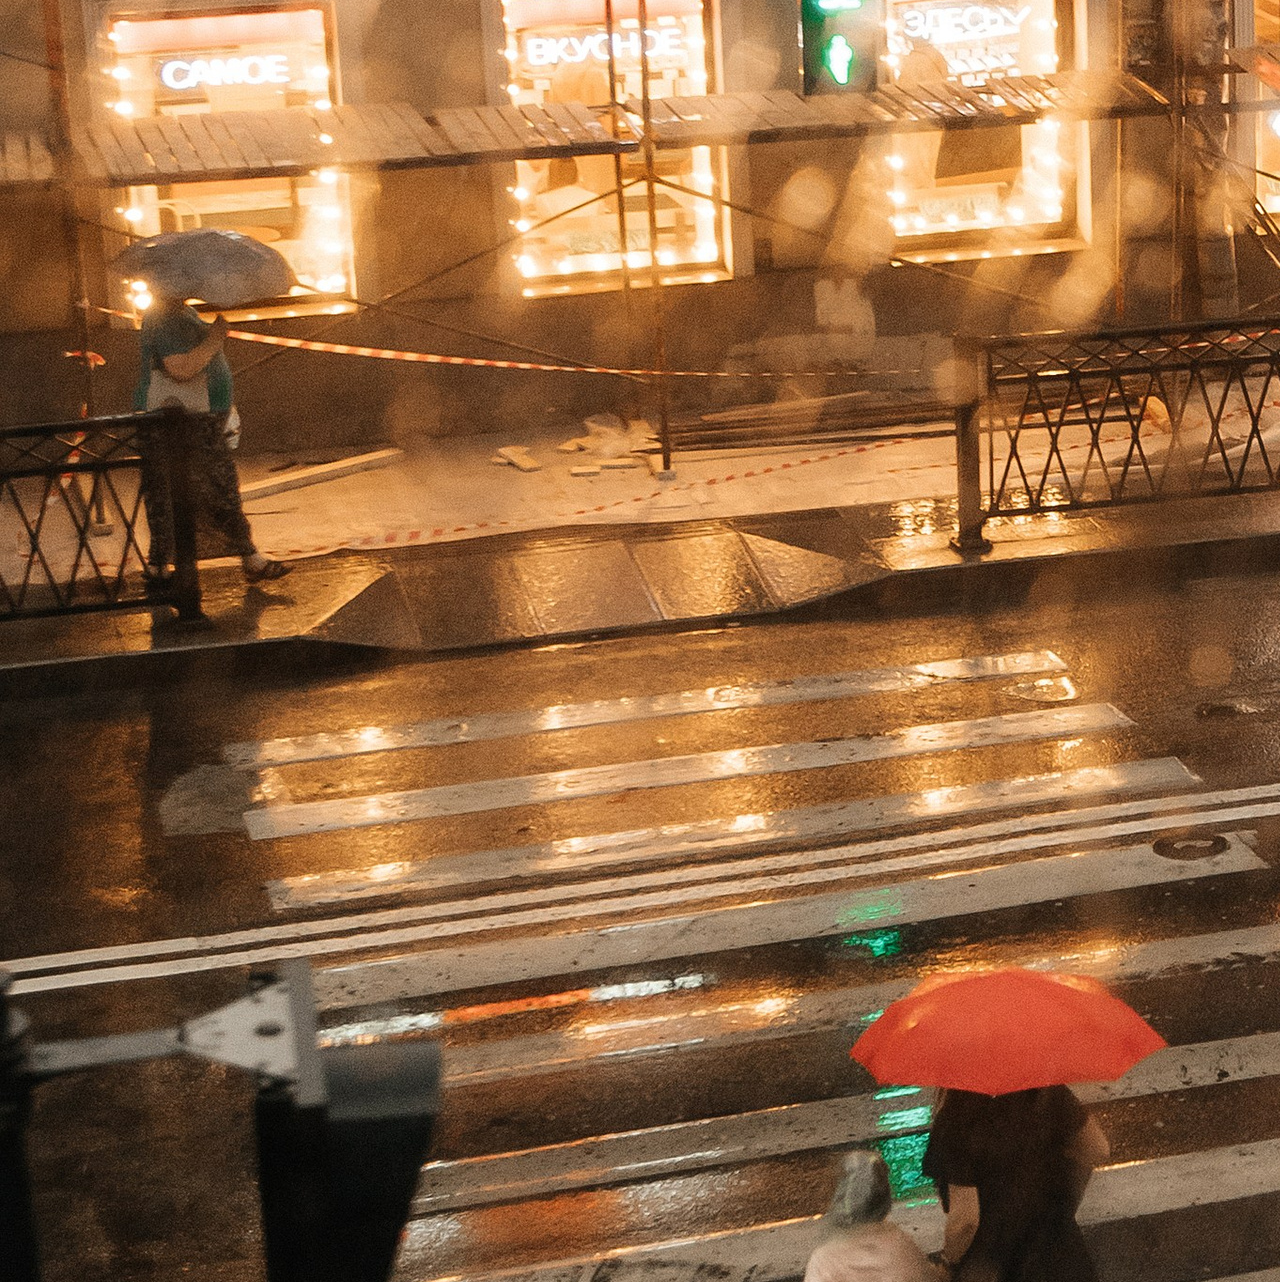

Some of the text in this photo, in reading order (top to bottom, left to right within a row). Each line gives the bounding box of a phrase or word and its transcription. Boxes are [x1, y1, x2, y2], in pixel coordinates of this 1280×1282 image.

[161, 6, 1001, 90] САМОЕ ВКУСНОЕ ЗДЕСЬ
